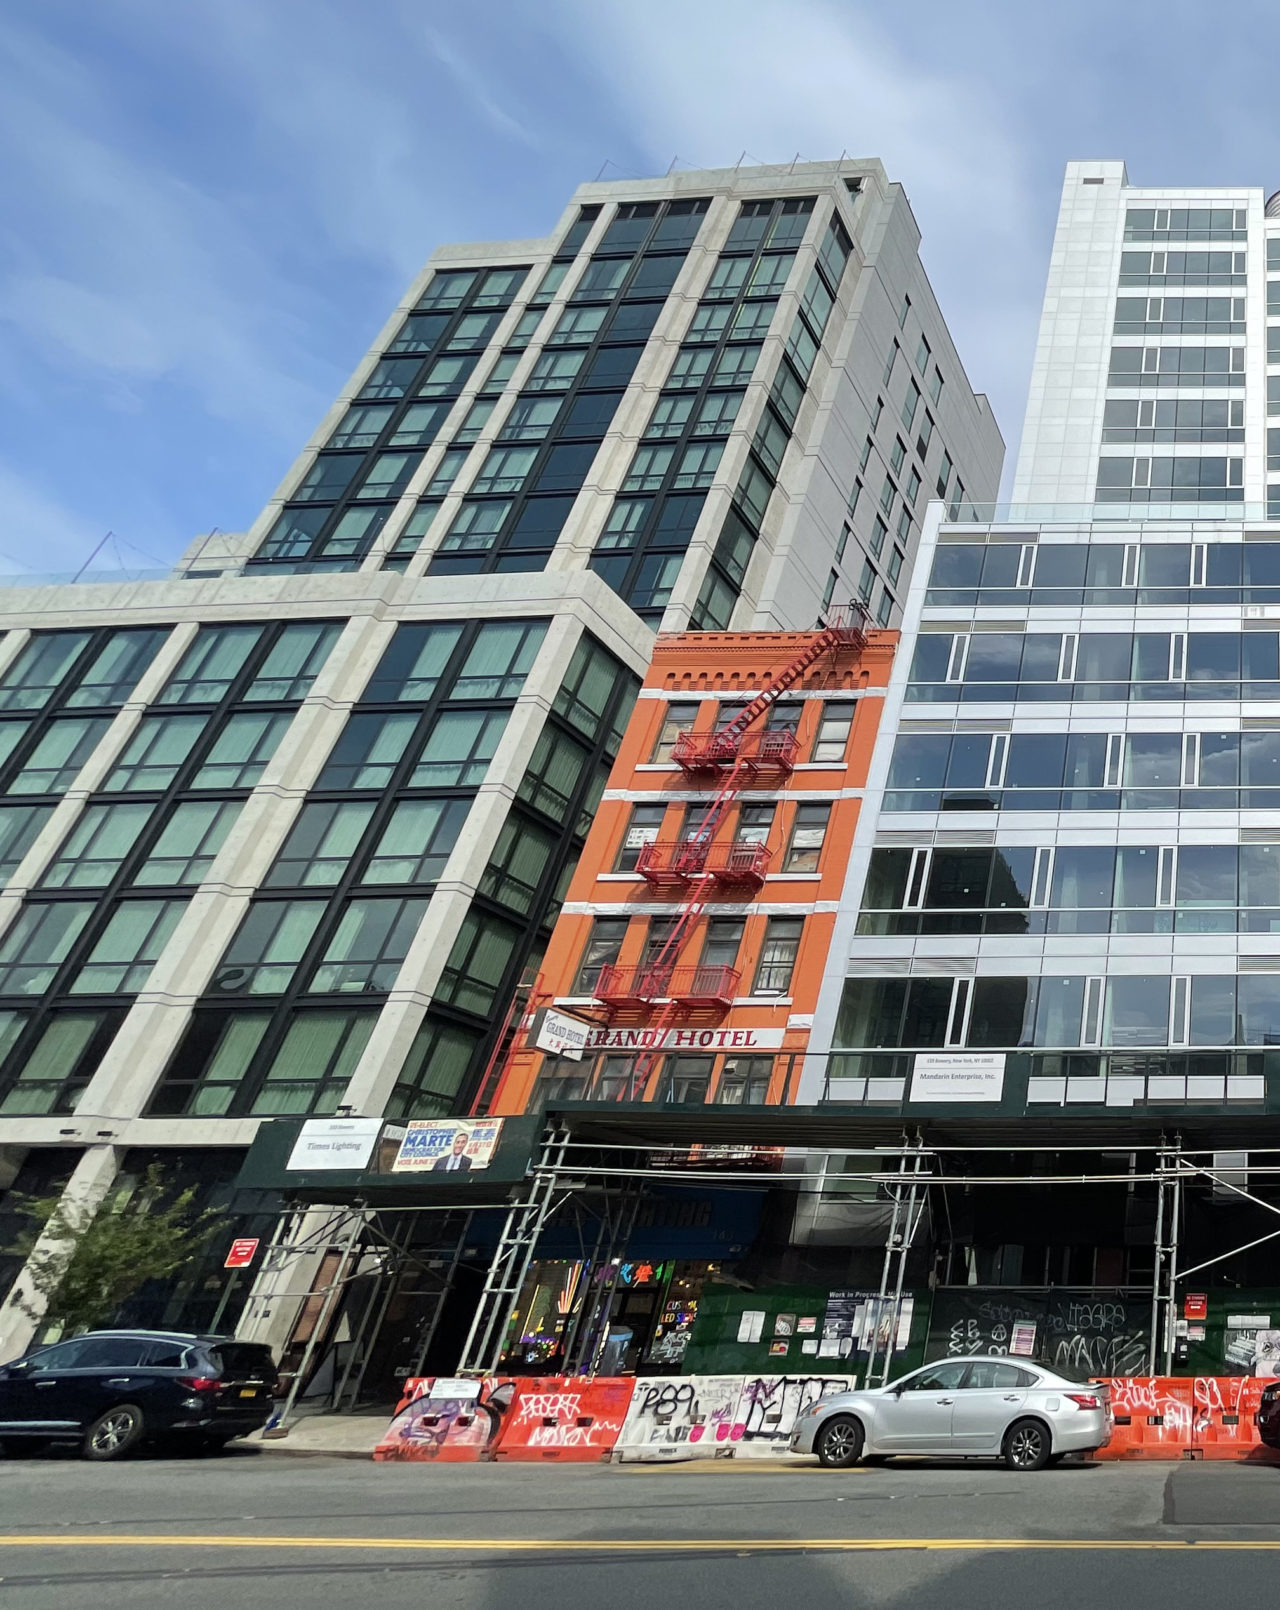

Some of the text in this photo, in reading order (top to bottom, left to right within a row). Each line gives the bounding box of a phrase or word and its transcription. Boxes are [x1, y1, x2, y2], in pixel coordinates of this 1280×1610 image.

[675, 1030, 757, 1047] HOTEL
[951, 1073, 983, 1081] Enterprise,
[307, 1142, 362, 1151] Times Lighting
[403, 1135, 453, 1147] MARTE
[661, 1312, 676, 1323] LED
